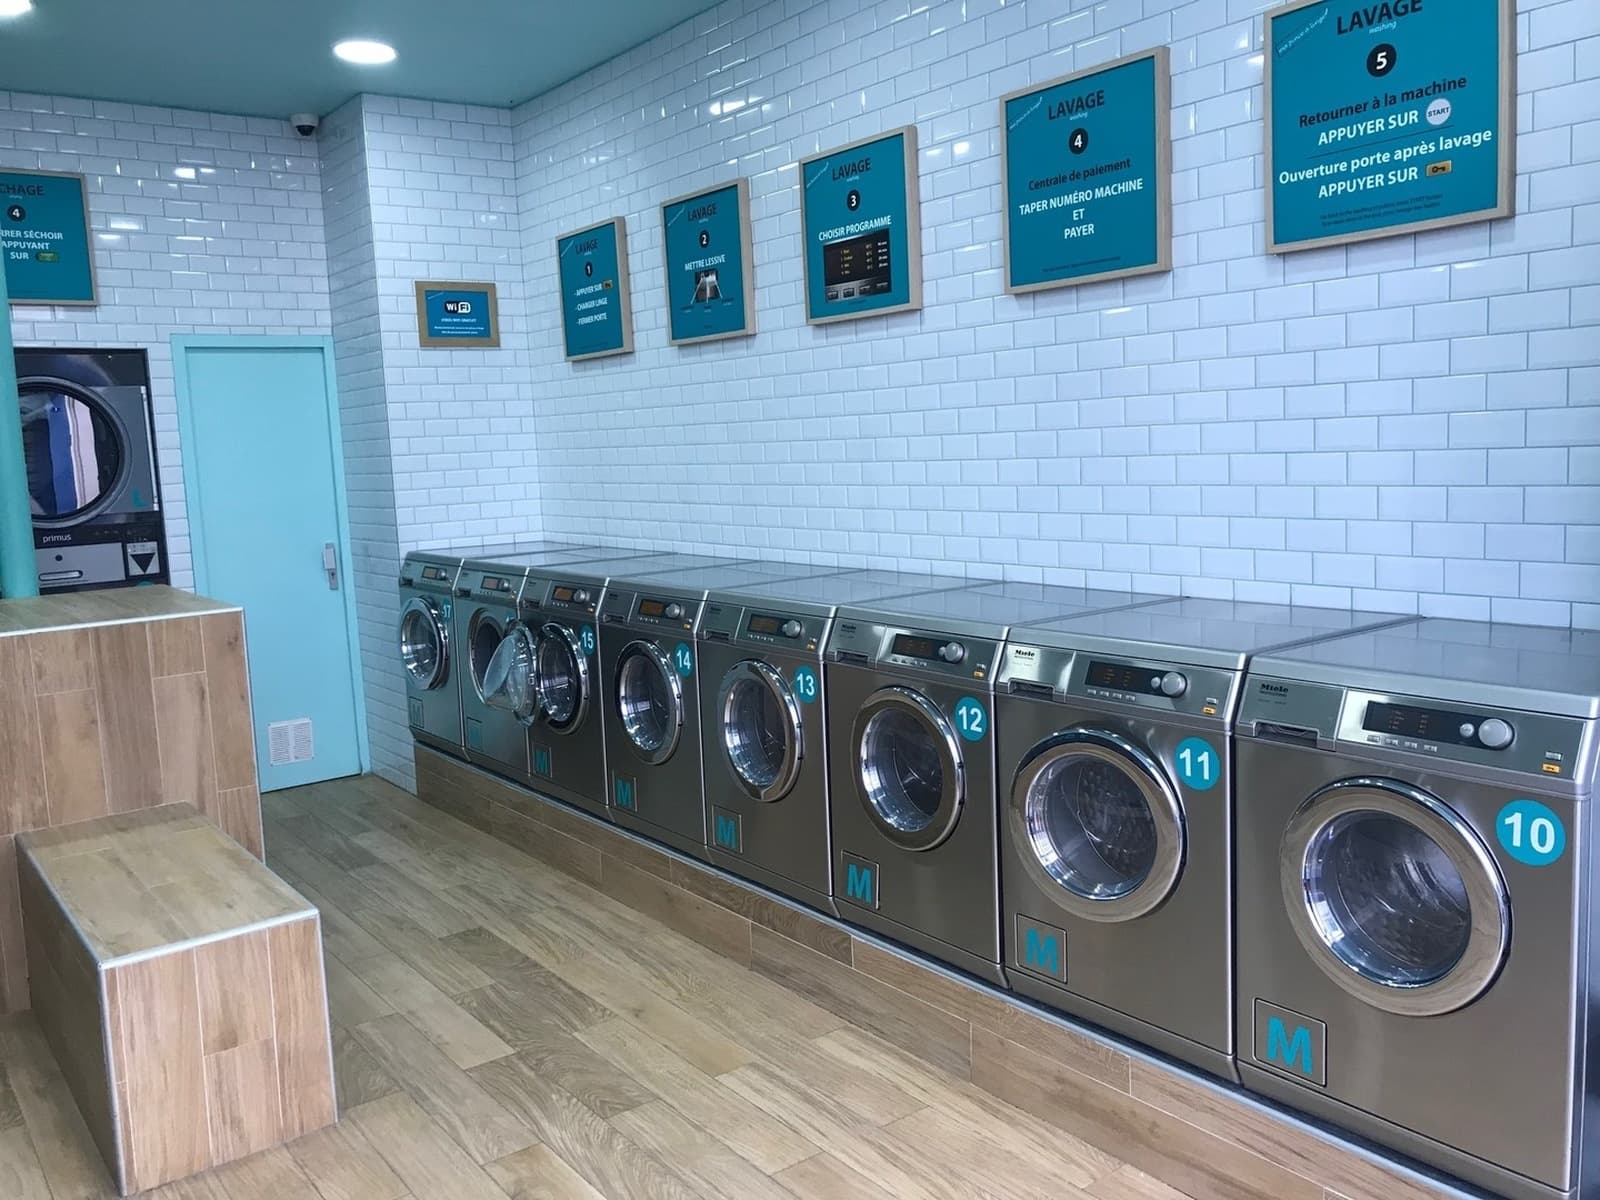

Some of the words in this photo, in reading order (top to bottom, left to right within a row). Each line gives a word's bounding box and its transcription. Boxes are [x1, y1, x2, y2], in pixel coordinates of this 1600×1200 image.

[1336, 0, 1423, 35] LAVAGE
[1375, 51, 1388, 70] 5
[1048, 89, 1105, 120] LAVAGE
[1300, 100, 1368, 128] Retourner
[1372, 93, 1380, 109] à
[1384, 92, 1396, 108] la
[1401, 76, 1467, 103] machine
[1318, 118, 1385, 146] APPUYER
[1388, 110, 1418, 130] SUR
[1428, 106, 1450, 118] START
[1073, 134, 1083, 148] 4
[1279, 160, 1348, 185] Ouverture
[1350, 151, 1390, 173] porte
[1394, 141, 1436, 162] après
[1440, 129, 1493, 152] lavage
[832, 158, 871, 181] LAVAGE
[1028, 174, 1067, 192] Centrale
[1069, 170, 1081, 182] de
[1083, 158, 1131, 181] paiement
[1318, 174, 1384, 199] APPUYER
[1388, 166, 1418, 185] SUR
[850, 194, 857, 207] 3
[1019, 200, 1048, 216] TAPER
[1049, 189, 1093, 210] NUMÉRO
[1094, 178, 1143, 199] MACHINE
[12, 208, 21, 218] 4
[687, 203, 717, 221] LAVAGE
[1072, 208, 1085, 221] ET
[23, 230, 63, 240] SÉCHOIR
[701, 234, 707, 245] 2
[818, 226, 845, 241] CHOISIR
[845, 215, 892, 235] PROGRAMME
[1064, 223, 1094, 239] PAYER
[1, 240, 50, 250] APPUYANT
[10, 251, 29, 260] SUR
[684, 258, 705, 271] METTRE
[705, 254, 726, 267] LESSIVE
[42, 533, 72, 544] primus
[581, 631, 594, 649] 15
[676, 650, 691, 670] 14
[1015, 649, 1035, 657] Miele
[796, 673, 815, 696] 13
[1260, 683, 1289, 693] Miele
[958, 706, 983, 732] 12
[534, 750, 549, 775] M
[1179, 748, 1210, 781] 11
[616, 777, 634, 809] M
[717, 815, 736, 849] M
[1504, 812, 1556, 854] 10
[847, 863, 873, 904] M
[1025, 927, 1058, 974] M
[1266, 1015, 1313, 1075] M
